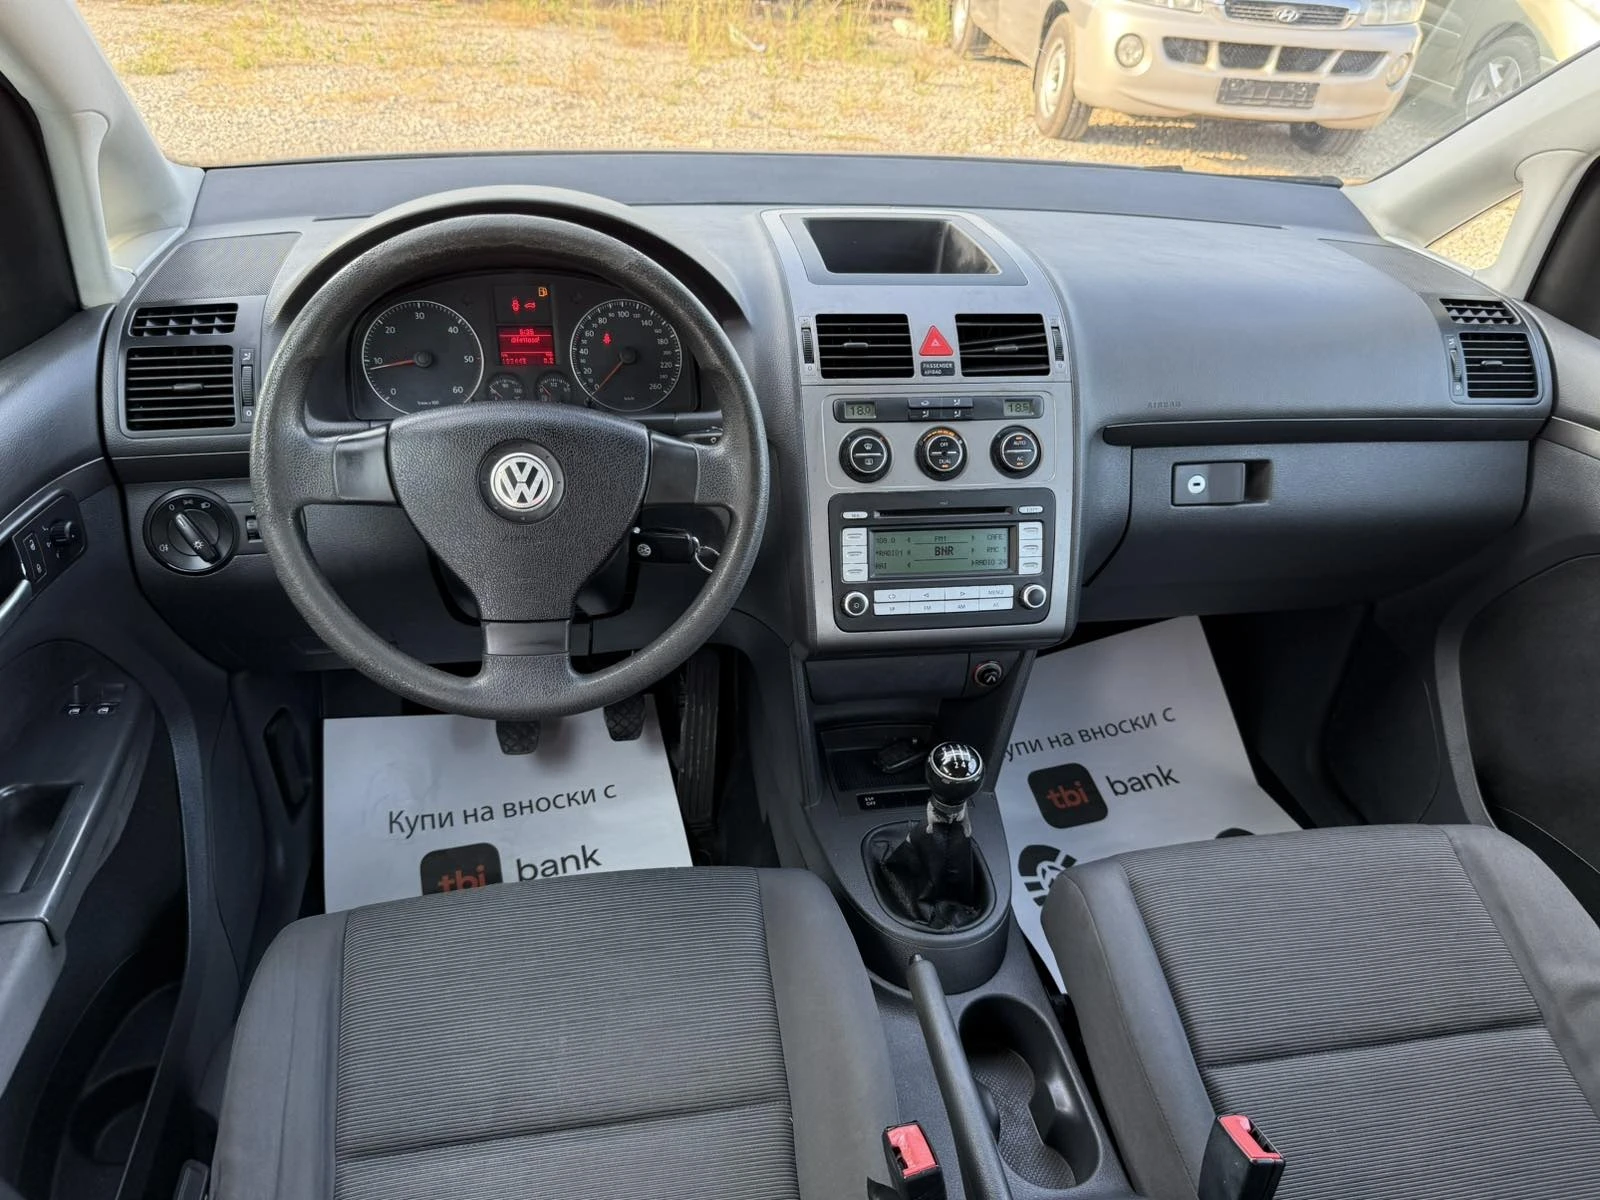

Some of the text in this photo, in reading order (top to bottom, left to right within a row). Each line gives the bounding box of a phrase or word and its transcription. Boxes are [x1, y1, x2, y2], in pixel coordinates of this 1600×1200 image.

[415, 312, 425, 320] 30
[385, 326, 396, 334] 20
[448, 326, 459, 334] 40
[390, 388, 397, 396] 0
[452, 386, 463, 394] 60
[849, 406, 872, 417] 18.0
[1008, 402, 1029, 413] 18.5
[494, 455, 551, 509] VW
[934, 546, 955, 557] BNR
[1004, 707, 1176, 762] упи на вноски с
[1105, 764, 1181, 797] bank
[1046, 780, 1090, 810] tbi
[388, 783, 617, 839] Купи на вноски с
[516, 844, 603, 882] bank
[438, 863, 487, 894] tbi
